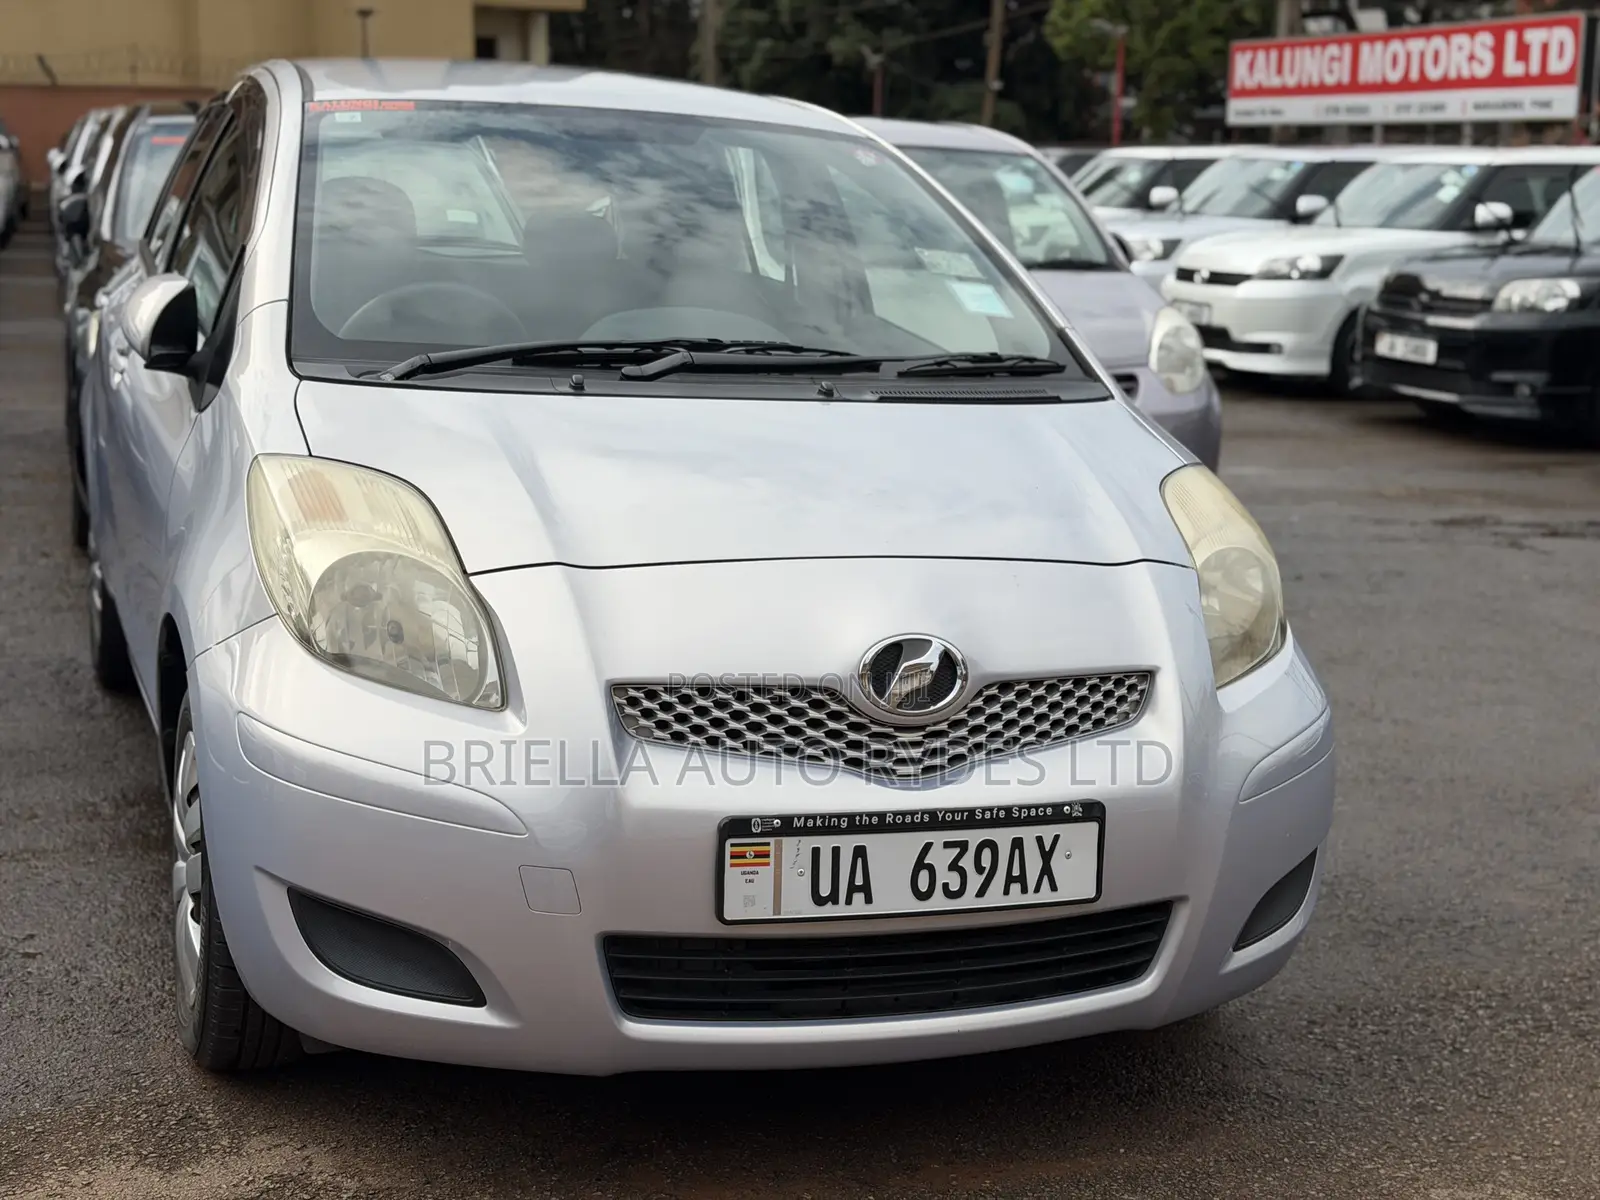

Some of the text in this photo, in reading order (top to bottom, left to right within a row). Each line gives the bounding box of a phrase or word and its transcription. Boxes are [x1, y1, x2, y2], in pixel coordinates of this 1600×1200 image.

[1233, 25, 1576, 90] KALUNGI MOTORS LTD
[793, 815, 848, 829] Making
[855, 813, 879, 826] the
[885, 810, 930, 825] Roads
[937, 809, 969, 822] Your
[975, 807, 1006, 820] Safe
[1012, 804, 1053, 819] Space
[810, 833, 1061, 907] UA 639AX
